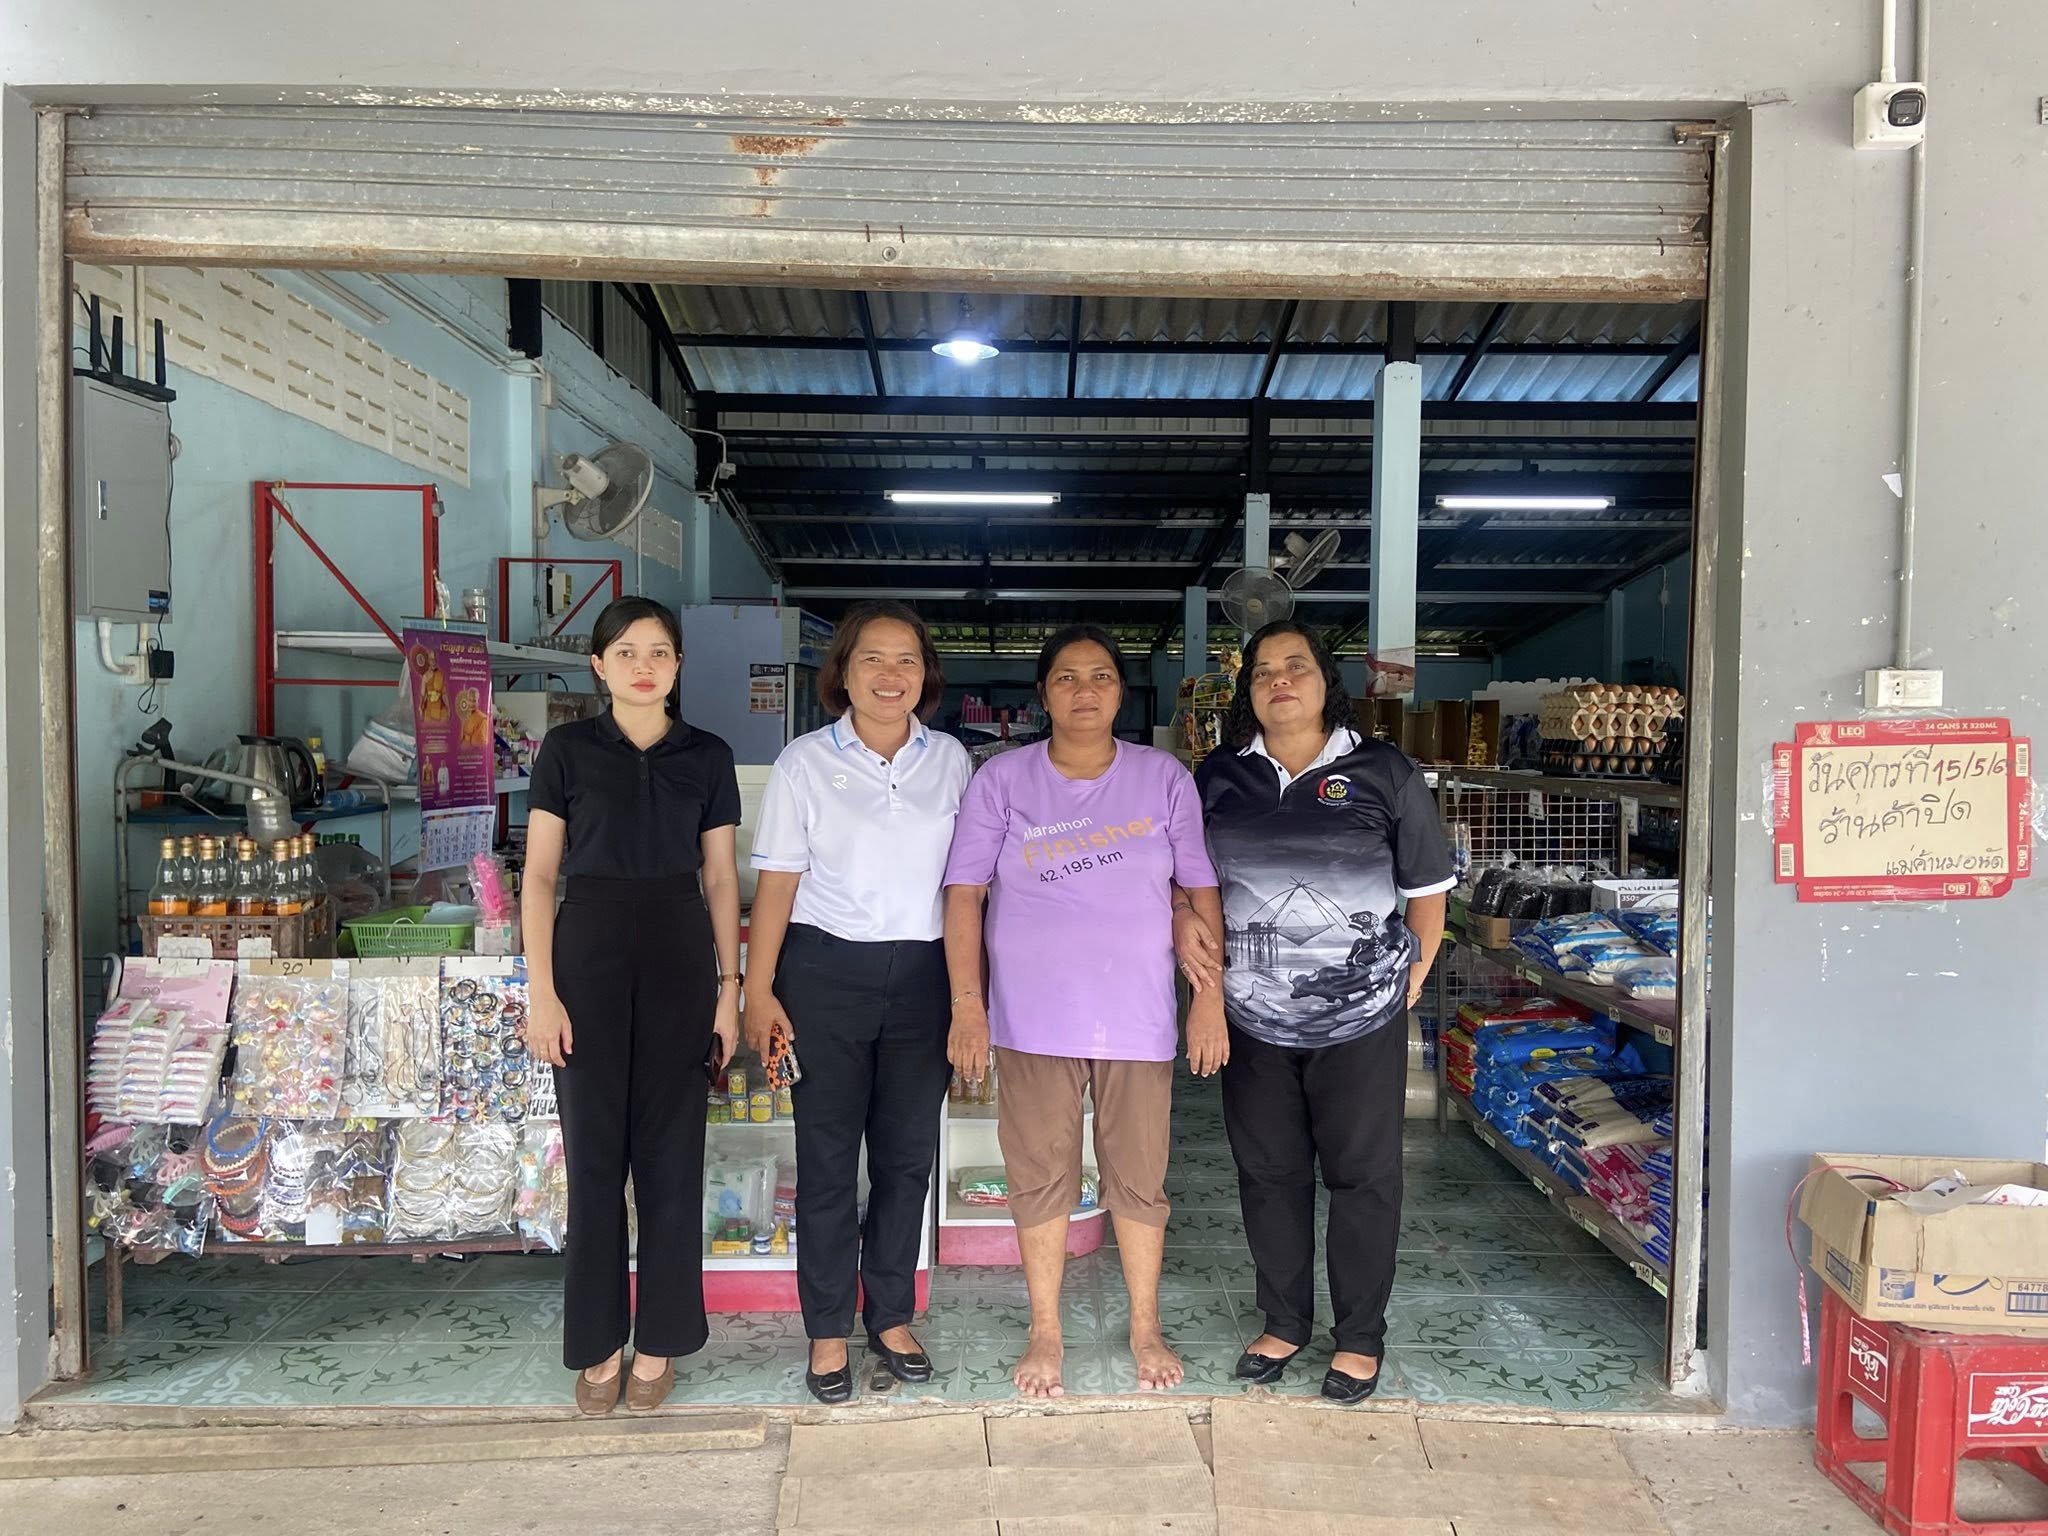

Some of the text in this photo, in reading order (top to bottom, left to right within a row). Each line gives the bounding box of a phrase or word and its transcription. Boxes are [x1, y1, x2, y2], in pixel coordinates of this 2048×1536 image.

[1840, 727, 1863, 737] LEO
[1023, 816, 1093, 842] Marathon
[1819, 788, 1972, 844] ร้านค้าปิด
[1023, 815, 1153, 872] Finisher
[1040, 851, 1124, 883] 42,195 km
[282, 961, 304, 976] 20
